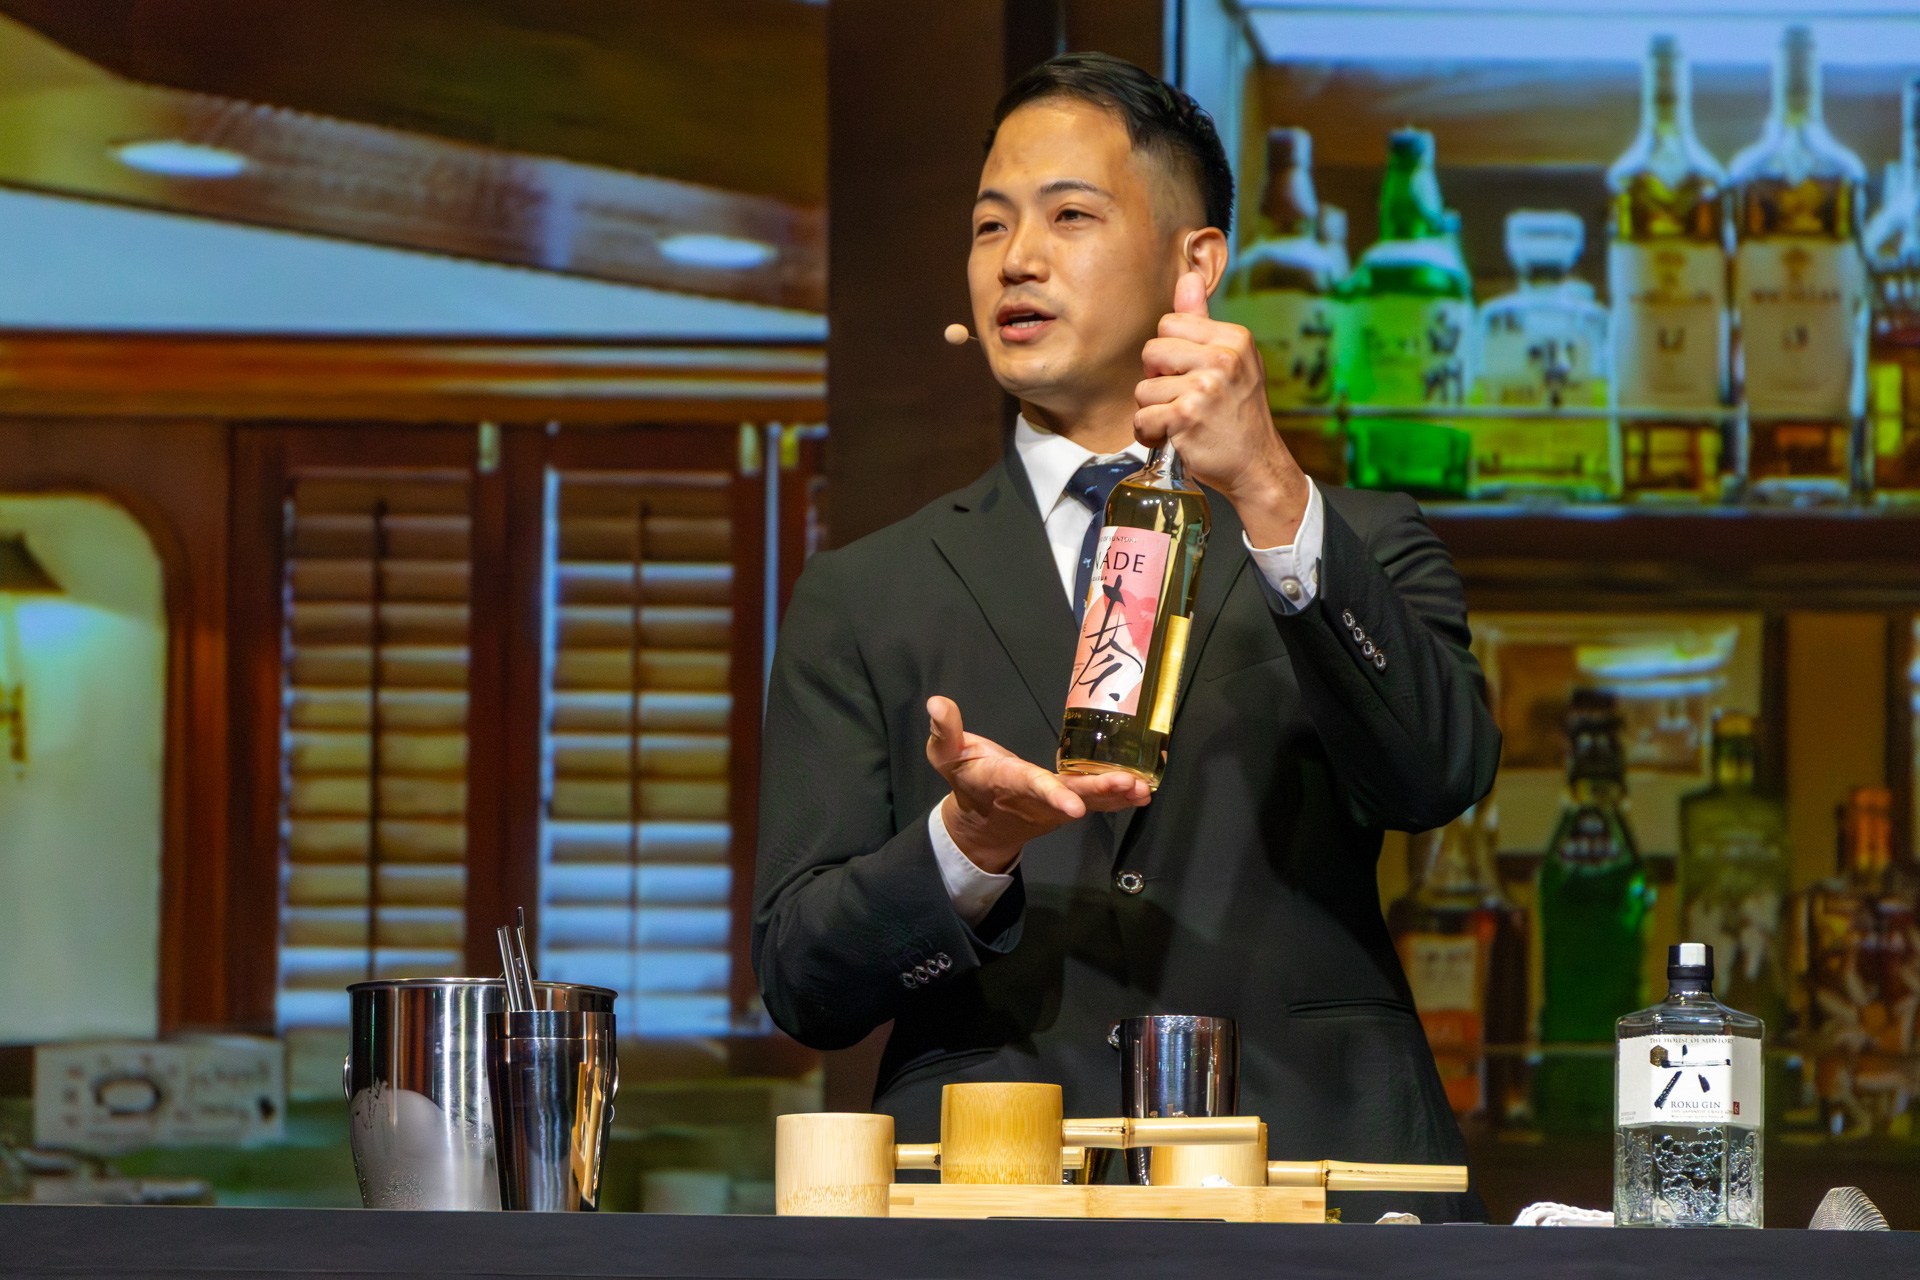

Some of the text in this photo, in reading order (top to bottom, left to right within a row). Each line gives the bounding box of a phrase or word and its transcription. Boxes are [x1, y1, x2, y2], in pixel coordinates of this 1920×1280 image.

[1650, 1037, 1661, 1045] THE
[1664, 1037, 1688, 1045] HOUSE
[1691, 1037, 1700, 1045] OF
[1654, 1044, 1731, 1110] 六
[1671, 1101, 1721, 1109] ROKU GIN
